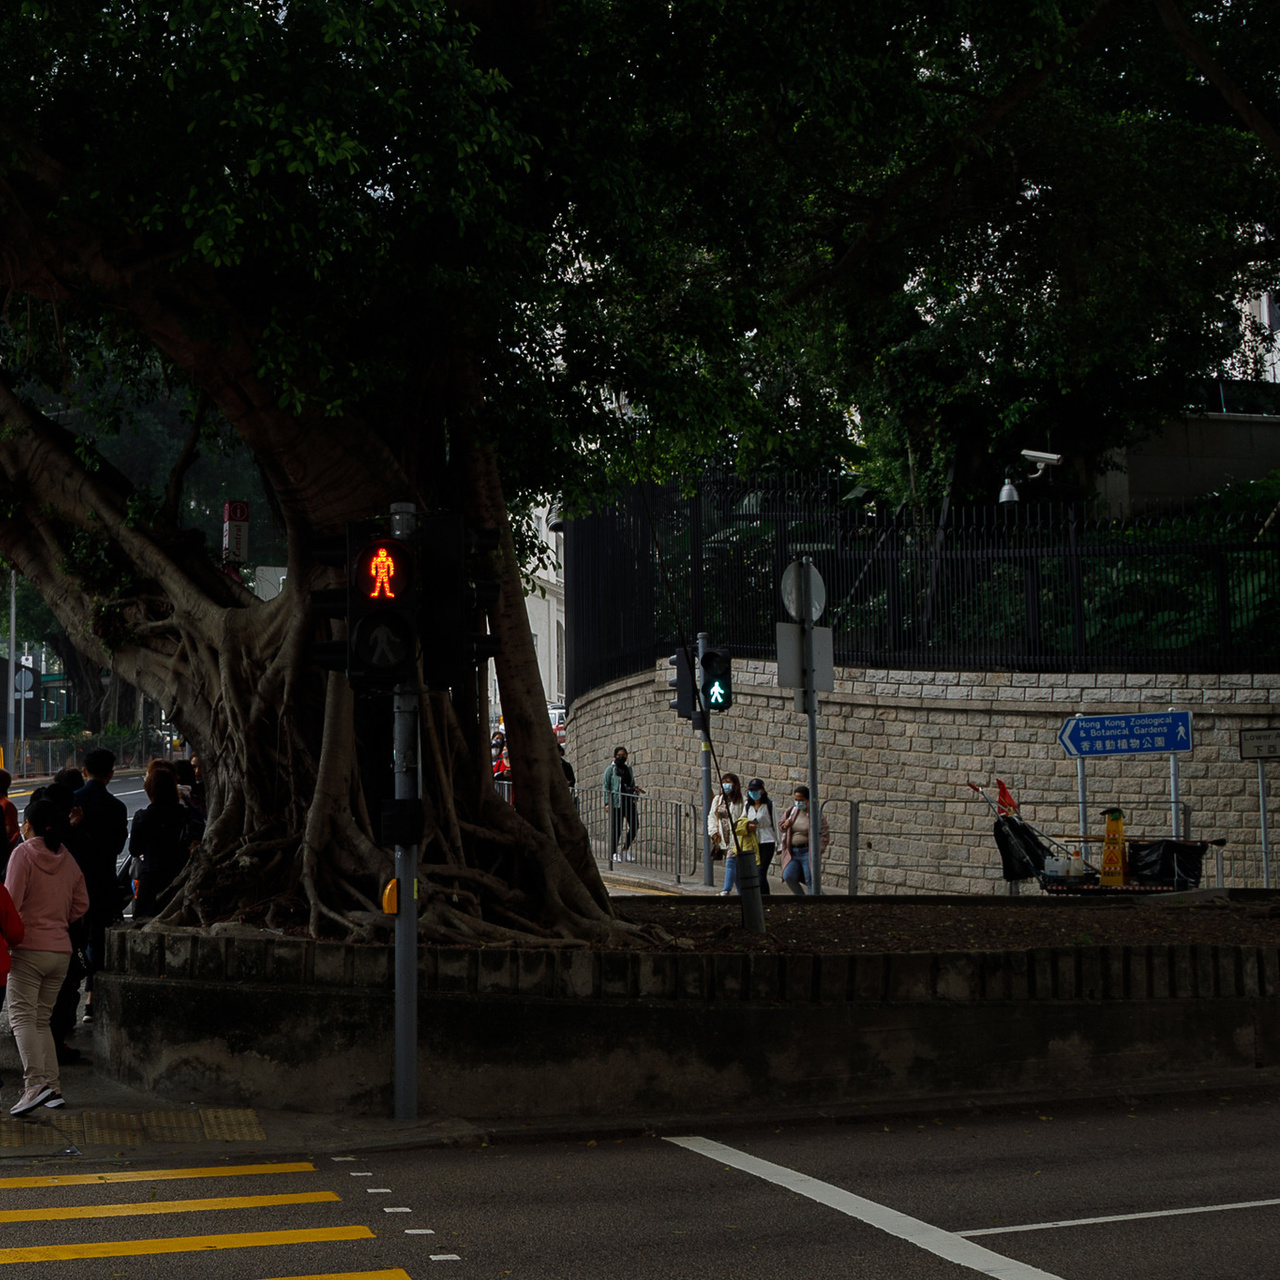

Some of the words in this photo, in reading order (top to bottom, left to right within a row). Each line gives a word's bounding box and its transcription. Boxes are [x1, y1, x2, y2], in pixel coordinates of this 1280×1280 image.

[232, 524, 242, 557] Central
[1079, 720, 1101, 730] Hong
[1104, 719, 1126, 728] Kong
[1129, 716, 1173, 727] Zoological
[1079, 729, 1087, 738] &
[1090, 726, 1130, 737] Botanical
[1133, 724, 1168, 735] Gardens
[1243, 733, 1272, 742] Lower
[1080, 736, 1166, 751] 香港動植物公園
